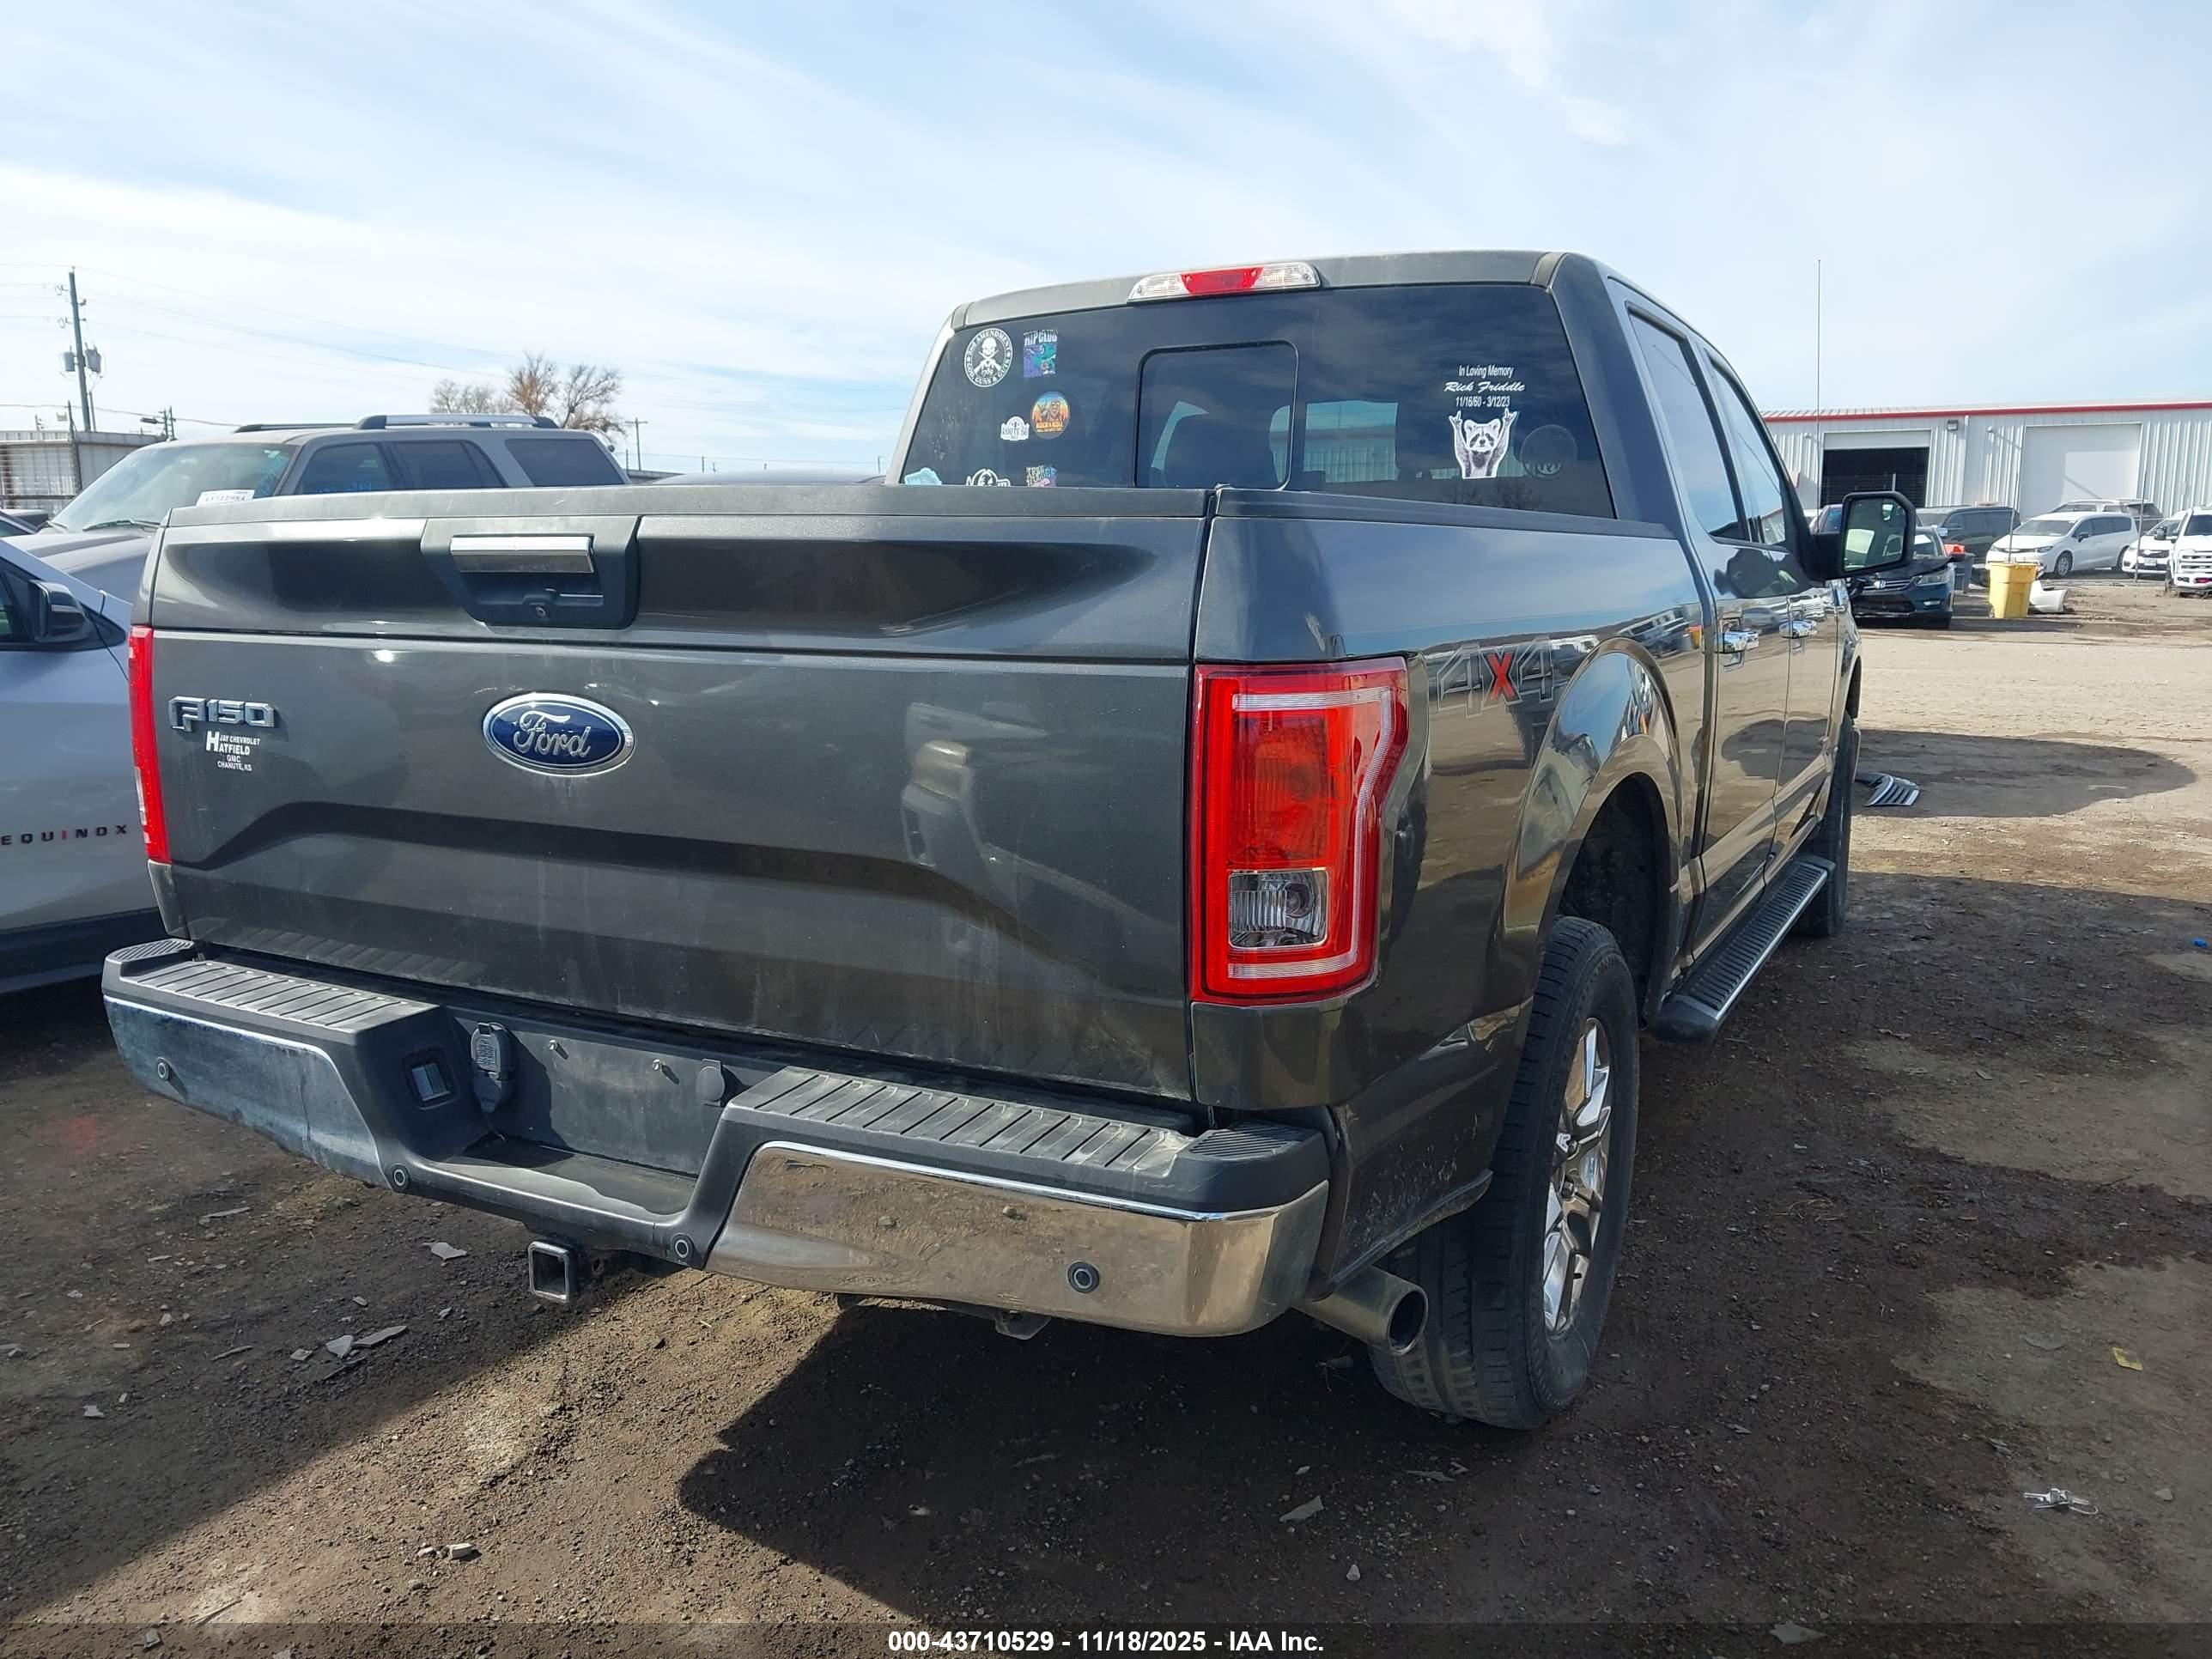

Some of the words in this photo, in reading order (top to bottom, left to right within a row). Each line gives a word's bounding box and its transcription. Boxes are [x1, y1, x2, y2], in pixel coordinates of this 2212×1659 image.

[1459, 365, 1465, 376] In
[1466, 365, 1487, 379] Loving
[1487, 364, 1514, 379] Memory
[1444, 381, 1474, 392] Rick
[1477, 381, 1525, 393] Friddle
[220, 734, 229, 743] JAY
[229, 736, 260, 745] CHEVROLET
[513, 710, 592, 757] Ford
[227, 754, 241, 763] GMC
[244, 763, 252, 772] KS
[1, 824, 127, 846] EQUINOX
